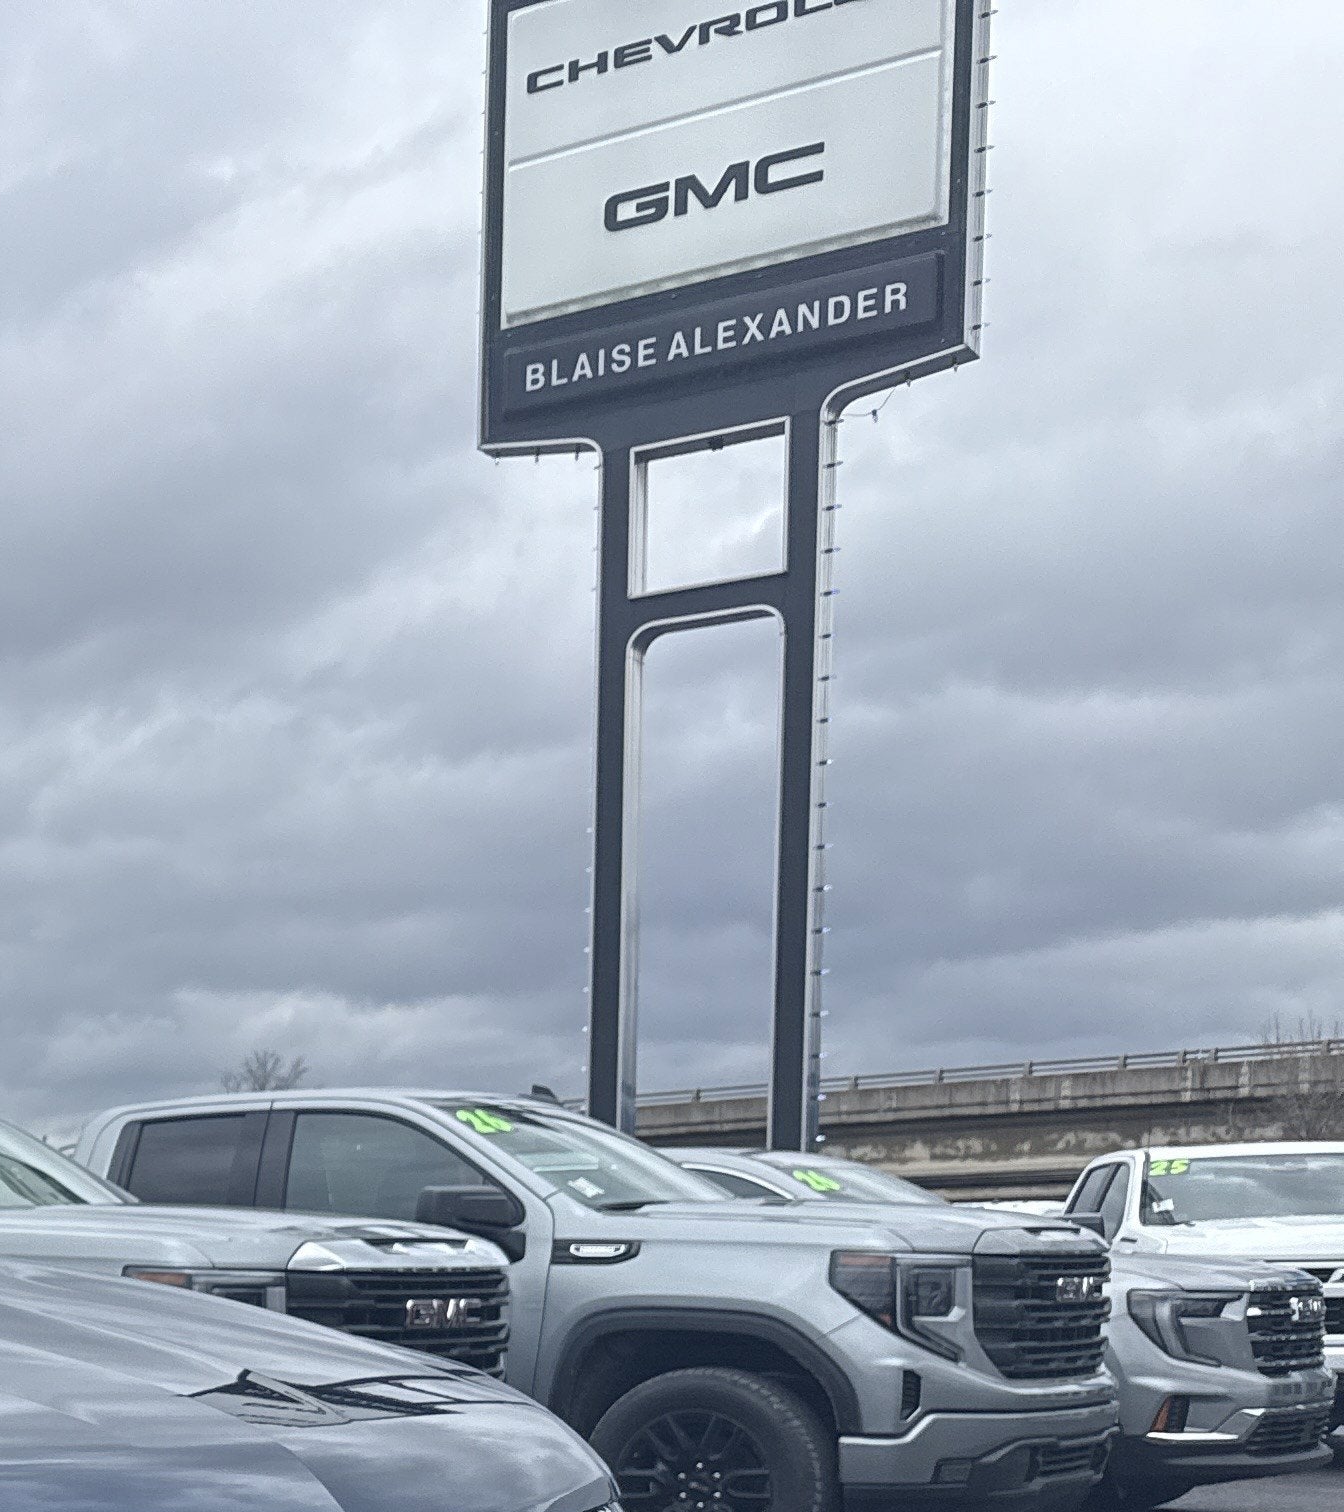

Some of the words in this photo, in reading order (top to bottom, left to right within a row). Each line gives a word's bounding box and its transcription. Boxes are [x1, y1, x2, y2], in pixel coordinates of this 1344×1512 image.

[527, 0, 859, 94] CHEVROL
[604, 142, 825, 233] GMC
[524, 337, 657, 393] BLAISE
[666, 282, 909, 362] ALEXANDER
